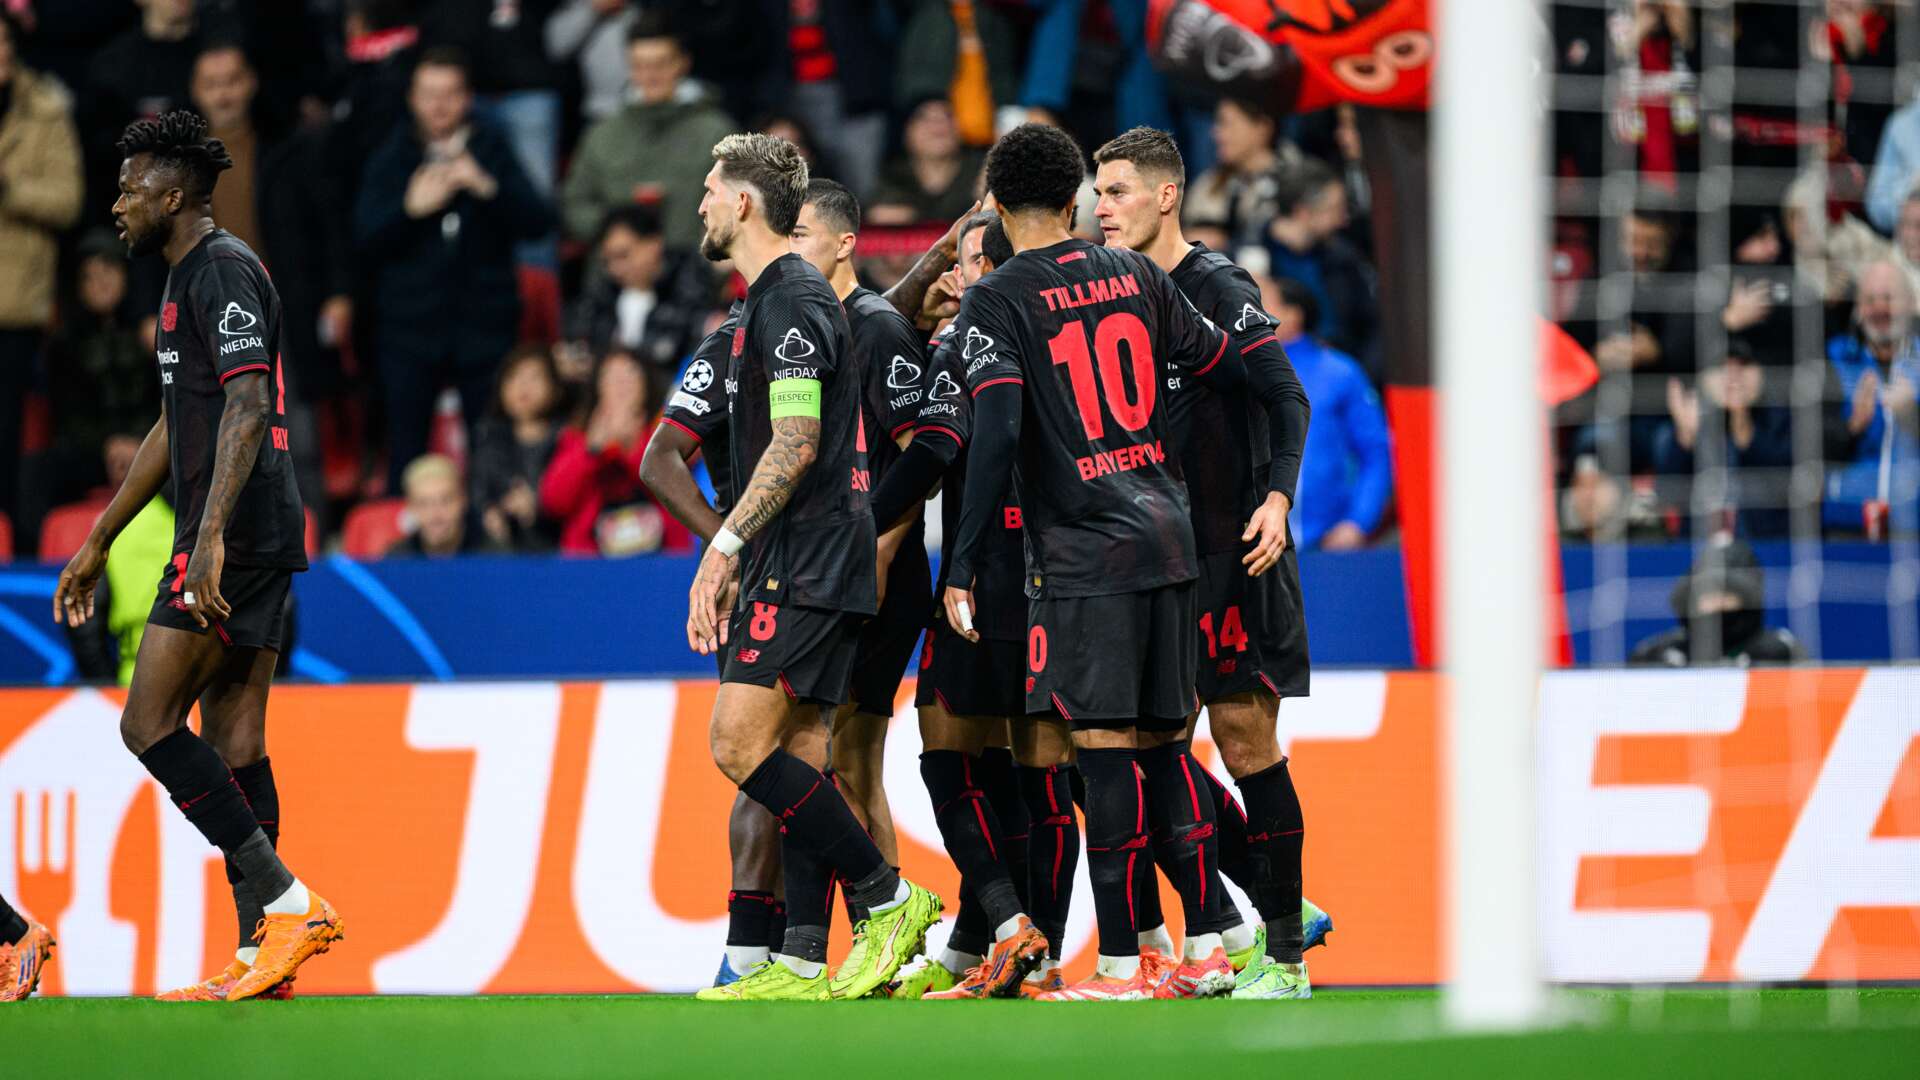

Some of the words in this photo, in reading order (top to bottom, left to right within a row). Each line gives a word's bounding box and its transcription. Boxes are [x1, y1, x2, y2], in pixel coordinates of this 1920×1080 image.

[1039, 273, 1141, 312] TILLMAN
[219, 336, 265, 356] NIEDAX
[965, 352, 1000, 379] NIEDAX
[1047, 312, 1157, 441] 10
[776, 392, 812, 403] RESPECT
[889, 389, 924, 411] NIED
[918, 403, 959, 418] NIEDAX
[1075, 444, 1147, 481] BAYER
[750, 600, 778, 642] 8
[1200, 606, 1249, 658] 14
